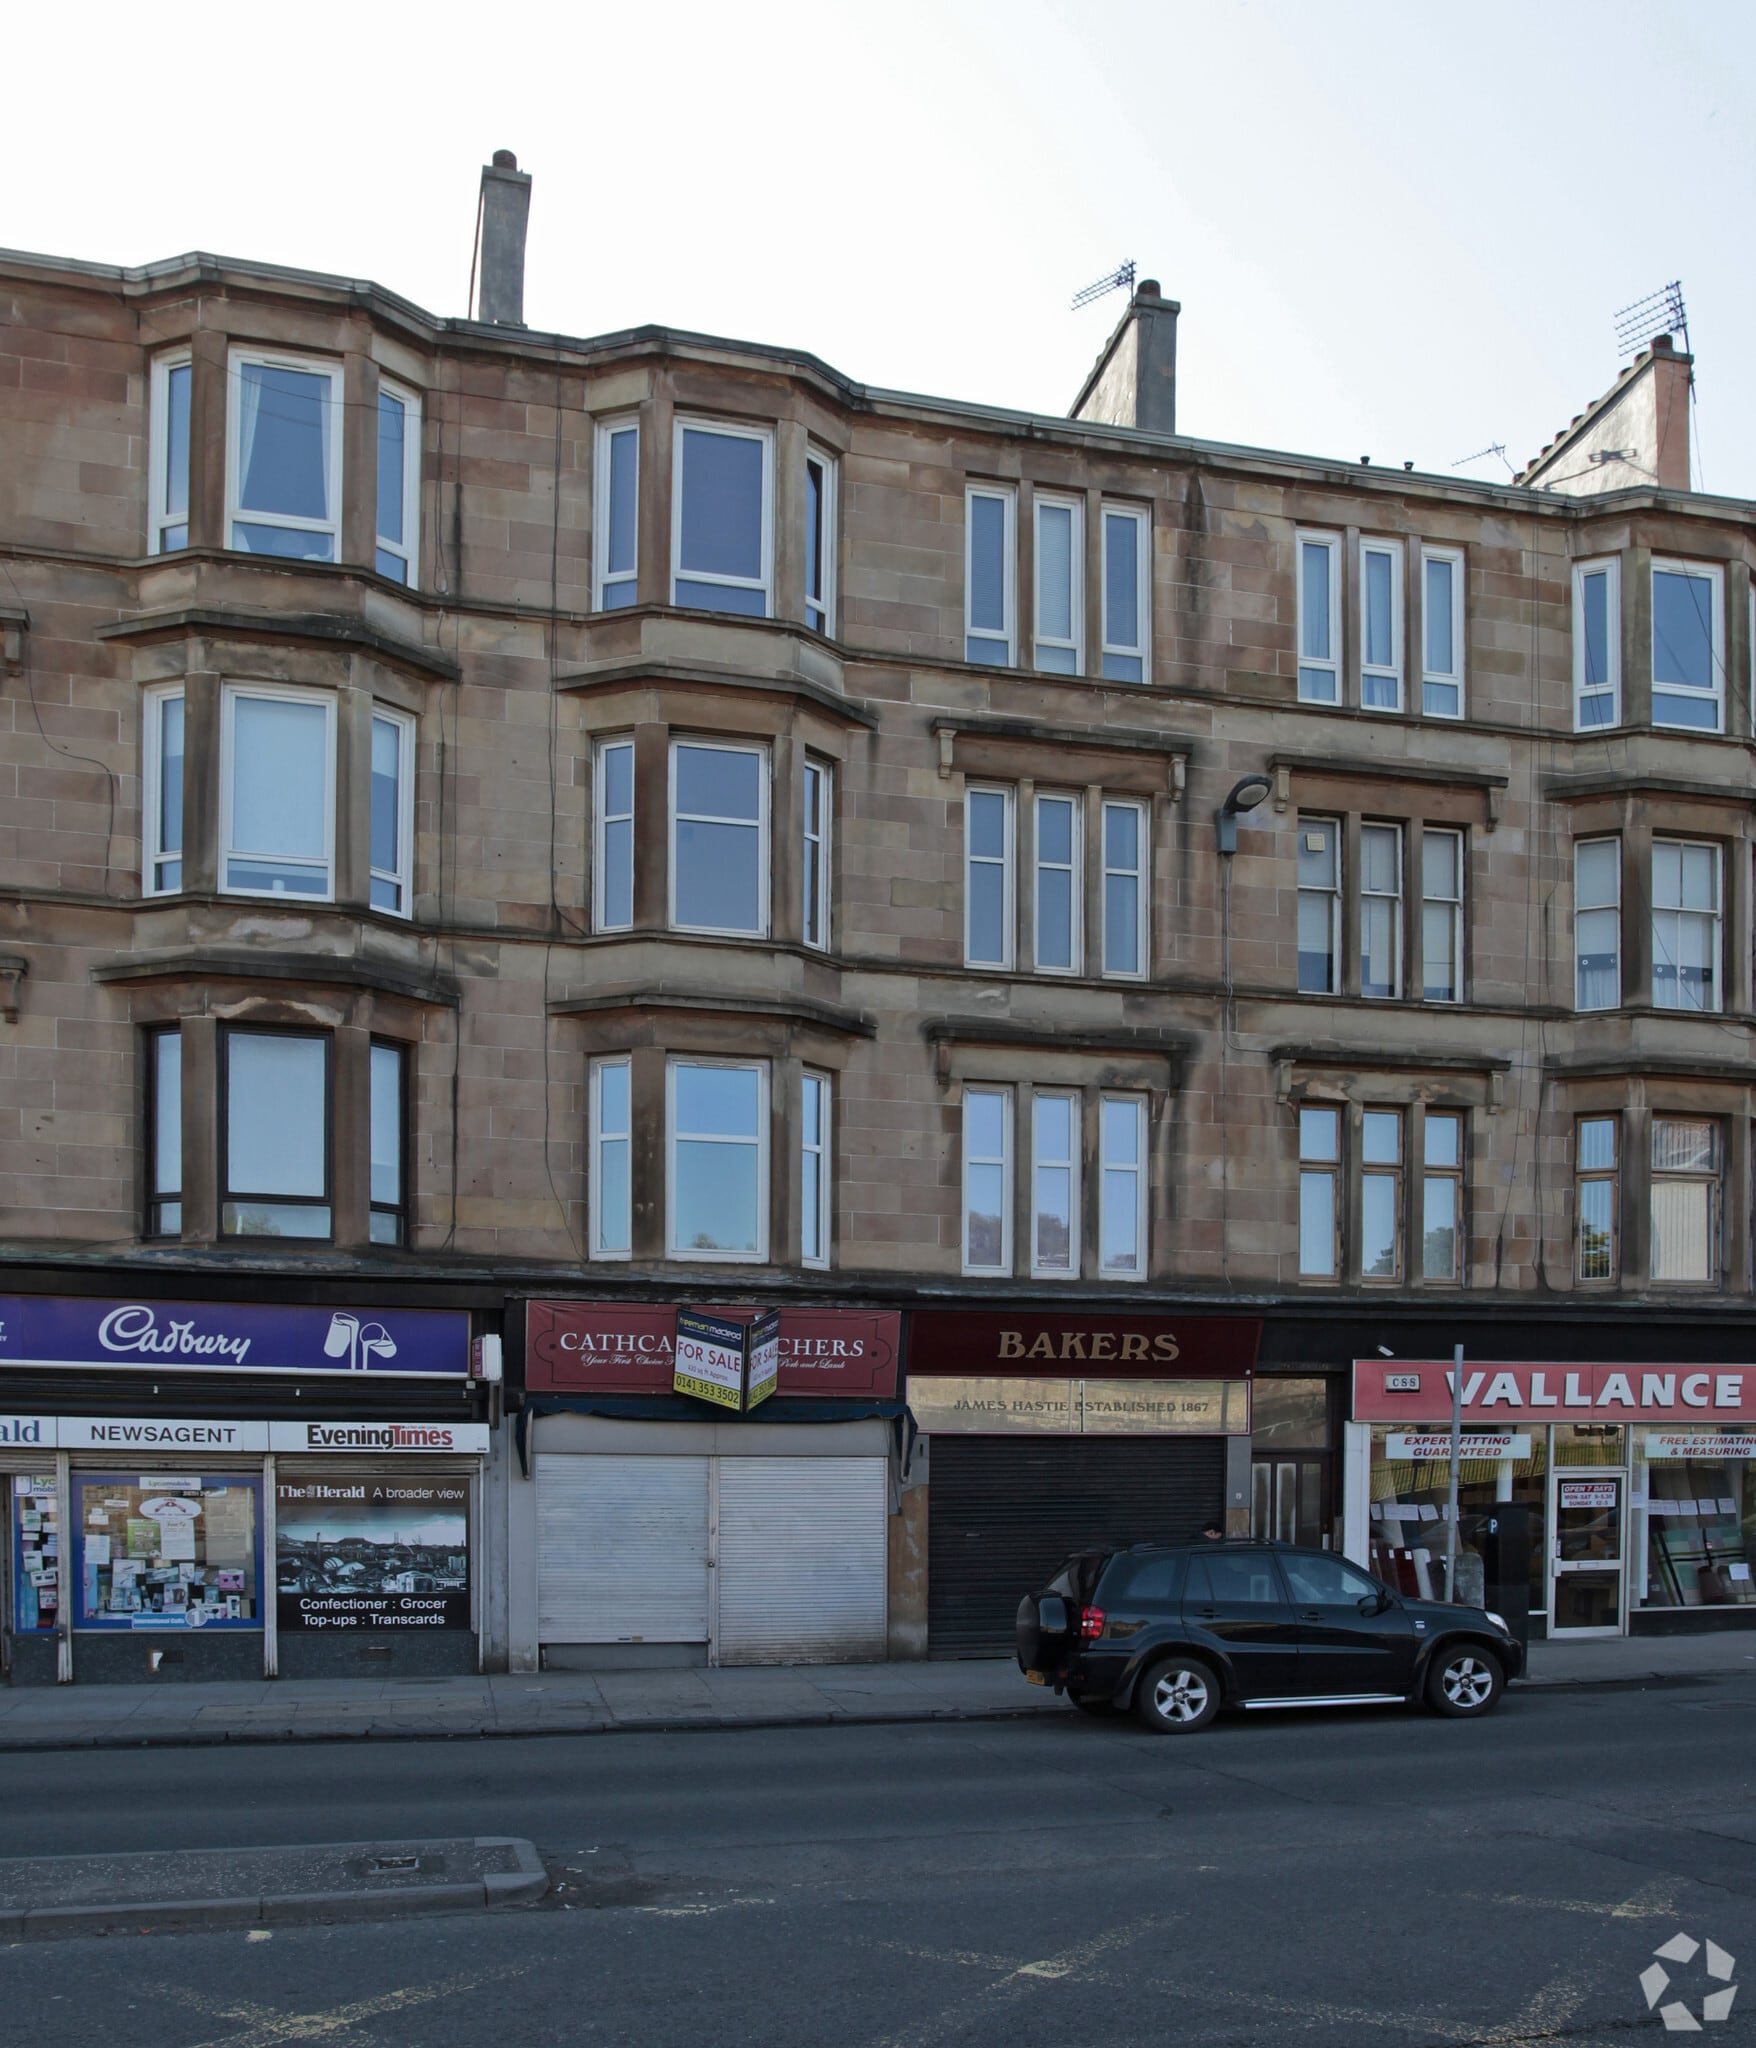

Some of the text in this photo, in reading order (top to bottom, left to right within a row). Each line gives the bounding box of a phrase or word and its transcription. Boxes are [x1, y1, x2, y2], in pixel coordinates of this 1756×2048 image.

[98, 1305, 251, 1364] Cadbury
[560, 1332, 674, 1353] CATHCA
[778, 1338, 864, 1357] CHERS
[997, 1331, 1180, 1361] BAKERS
[581, 1352, 607, 1367] Your
[609, 1354, 632, 1365] First
[634, 1354, 663, 1365] Choice
[677, 1341, 703, 1362] FOR
[708, 1350, 741, 1373] SALE
[800, 1360, 817, 1368] and
[818, 1359, 846, 1369] Lamb
[676, 1375, 696, 1391] 0141
[698, 1382, 715, 1396] 353
[716, 1387, 739, 1404] 3502
[1446, 1371, 1744, 1408] VALLANCE
[953, 1400, 1209, 1413] JAMES HASTIE ESTABLISHED 1867
[91, 1425, 236, 1443] NEWSAGENT
[1660, 1436, 1689, 1445] FREE
[1404, 1436, 1511, 1446] EXPERT FITTING
[1413, 1448, 1502, 1456] GUARNTEED
[1670, 1447, 1751, 1456] & MEASURING
[32, 1475, 56, 1487] Lyc
[277, 1485, 464, 1498] The Herald A broader view
[300, 1598, 388, 1610] Confectioner
[400, 1598, 447, 1609] Grocer
[302, 1613, 357, 1627] Top-ups
[370, 1613, 445, 1625] Transcards
